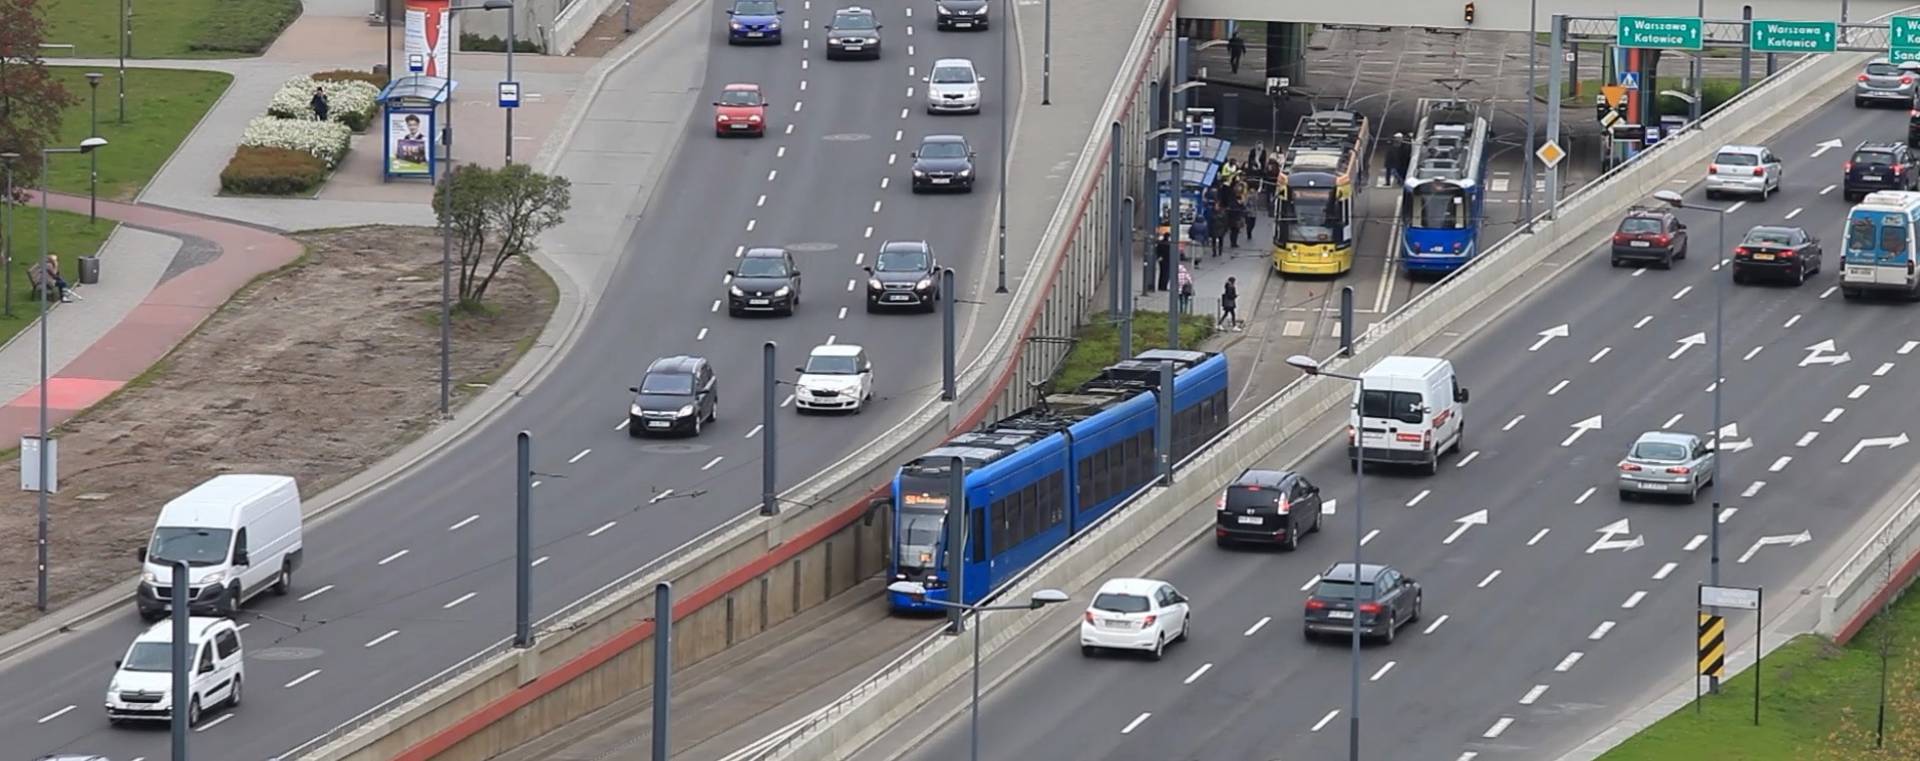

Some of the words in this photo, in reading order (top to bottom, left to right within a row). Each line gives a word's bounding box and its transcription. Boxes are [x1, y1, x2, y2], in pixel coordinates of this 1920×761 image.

[1634, 20, 1687, 31] Warszawa
[1767, 24, 1821, 35] Warszawa
[1634, 33, 1684, 44] Katowice
[1767, 37, 1817, 48] Katowice
